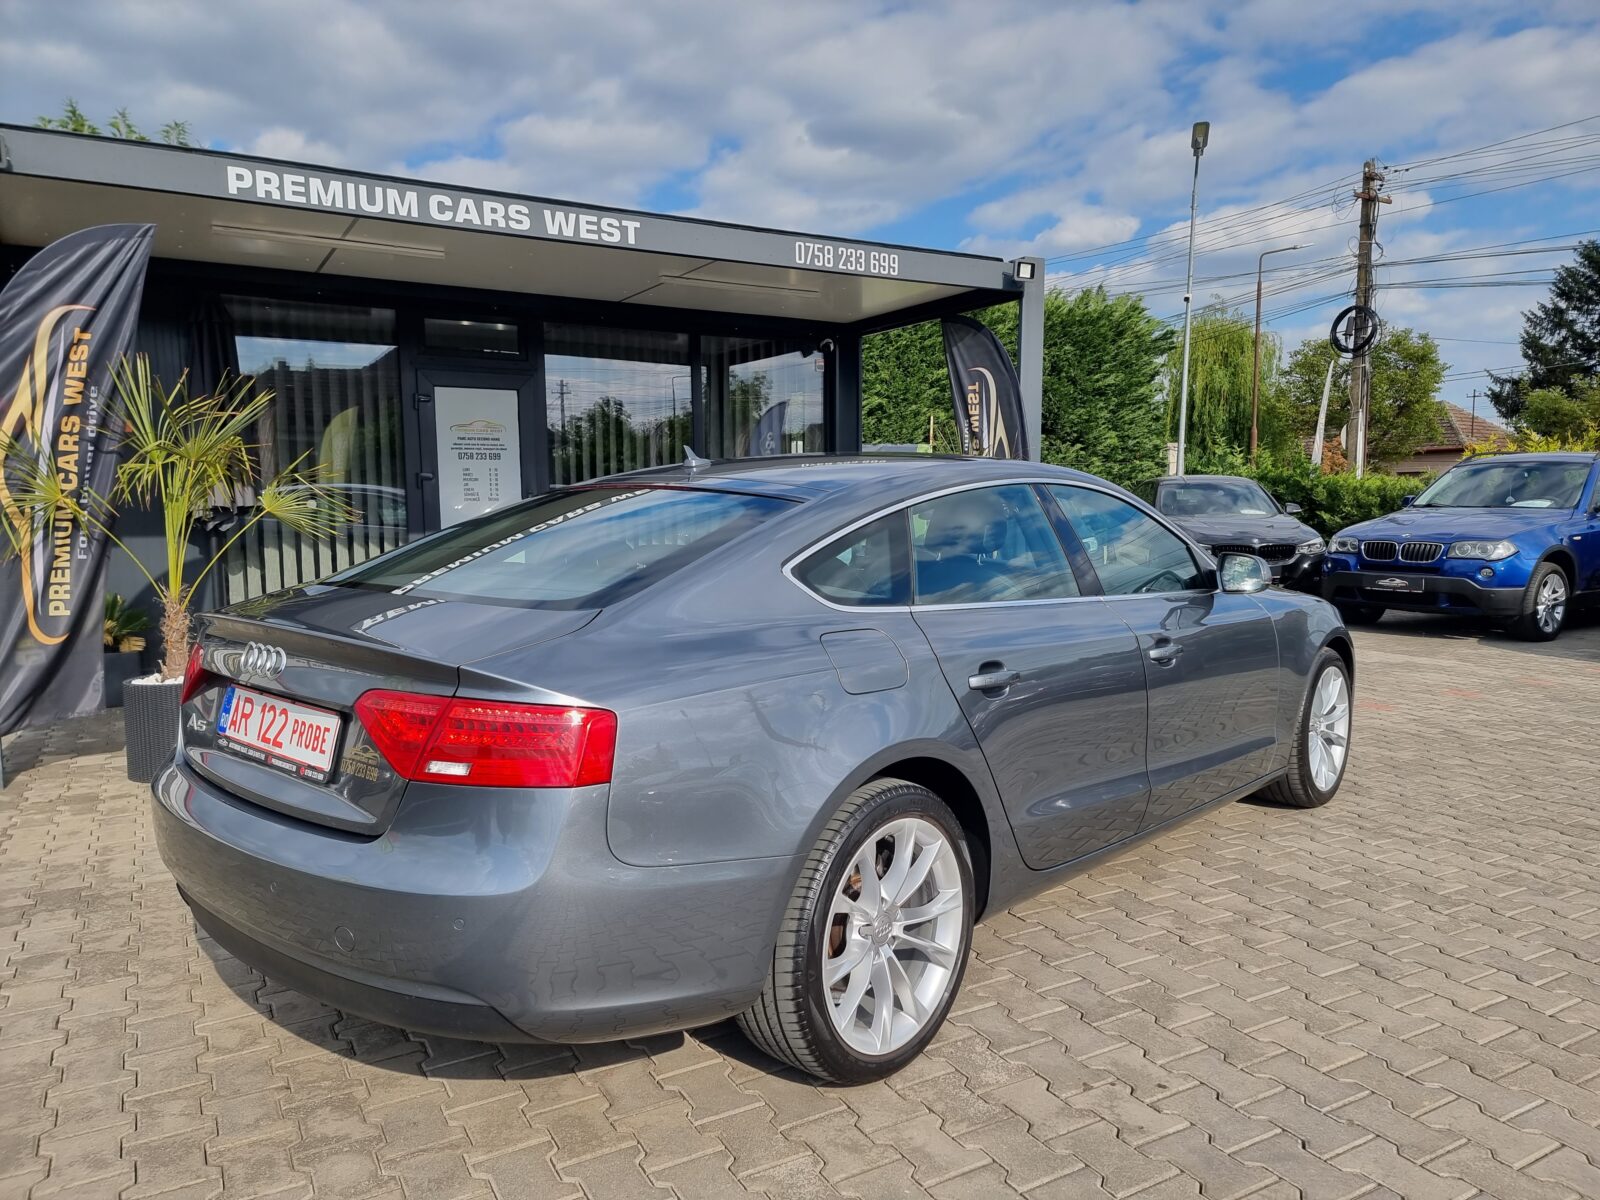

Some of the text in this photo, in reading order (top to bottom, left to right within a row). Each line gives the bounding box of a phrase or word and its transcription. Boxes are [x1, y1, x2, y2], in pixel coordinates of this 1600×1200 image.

[227, 165, 641, 245] PREMIUM CARS WEST
[795, 241, 899, 276] 0758 233 699
[86, 385, 98, 437] drive
[49, 327, 92, 617] PREMIUM CARS WEST
[458, 452, 501, 461] 0758 233 699
[187, 712, 207, 732] A5
[228, 694, 255, 737] AR
[257, 702, 289, 749] 122
[290, 718, 331, 755] PROBE
